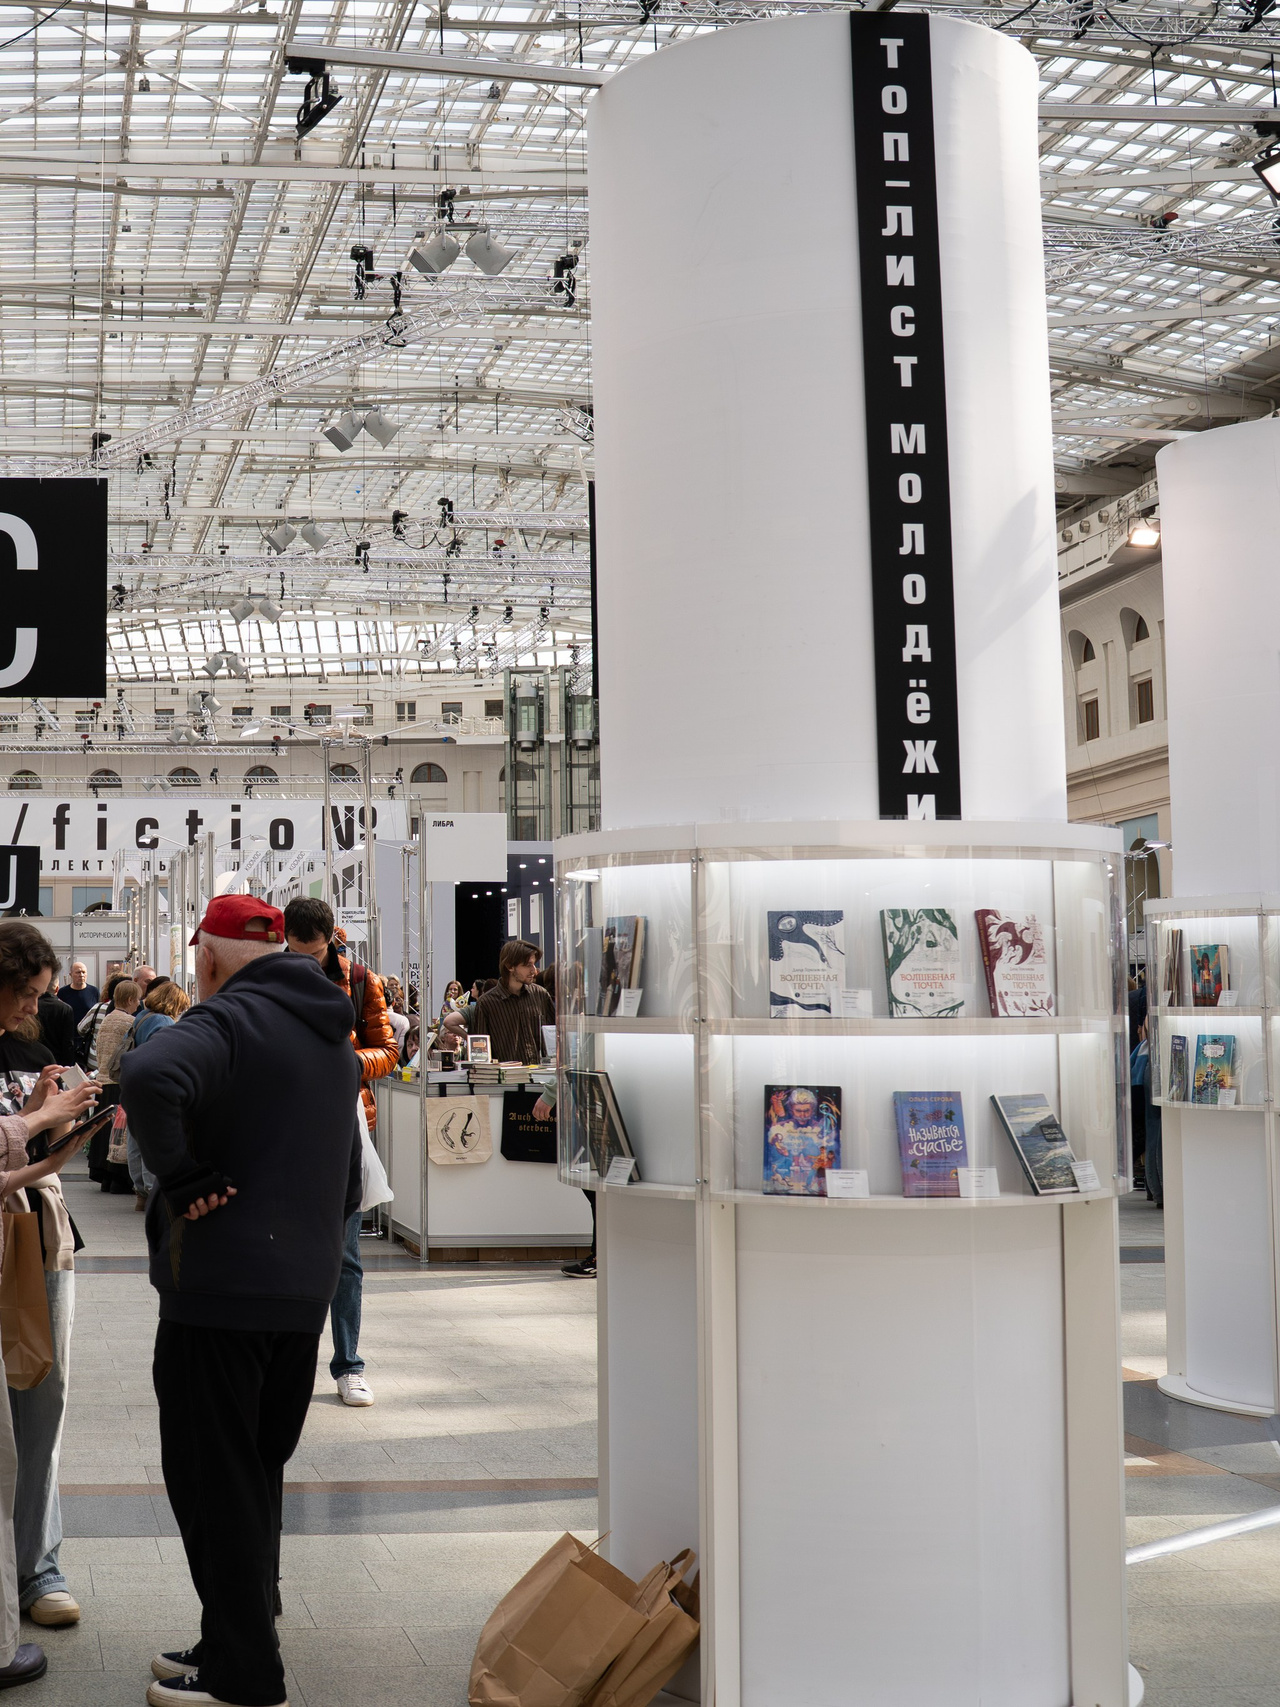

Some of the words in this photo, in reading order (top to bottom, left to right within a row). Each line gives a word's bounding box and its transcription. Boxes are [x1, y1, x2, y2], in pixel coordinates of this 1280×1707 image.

[432, 820, 455, 828] ЛИБРА
[79, 931, 123, 939] ИСТОРИЧЕСКИЙ
[780, 974, 838, 982] ВОЛШЕБНАЯ
[900, 973, 956, 981] ВОЛШЕБНАЯ
[1001, 973, 1045, 981] ВОЛШЕБНАЯ
[793, 982, 825, 990] ПОЧТА
[913, 981, 944, 990] ПОЧТА
[1012, 981, 1037, 990] ПОЧТА
